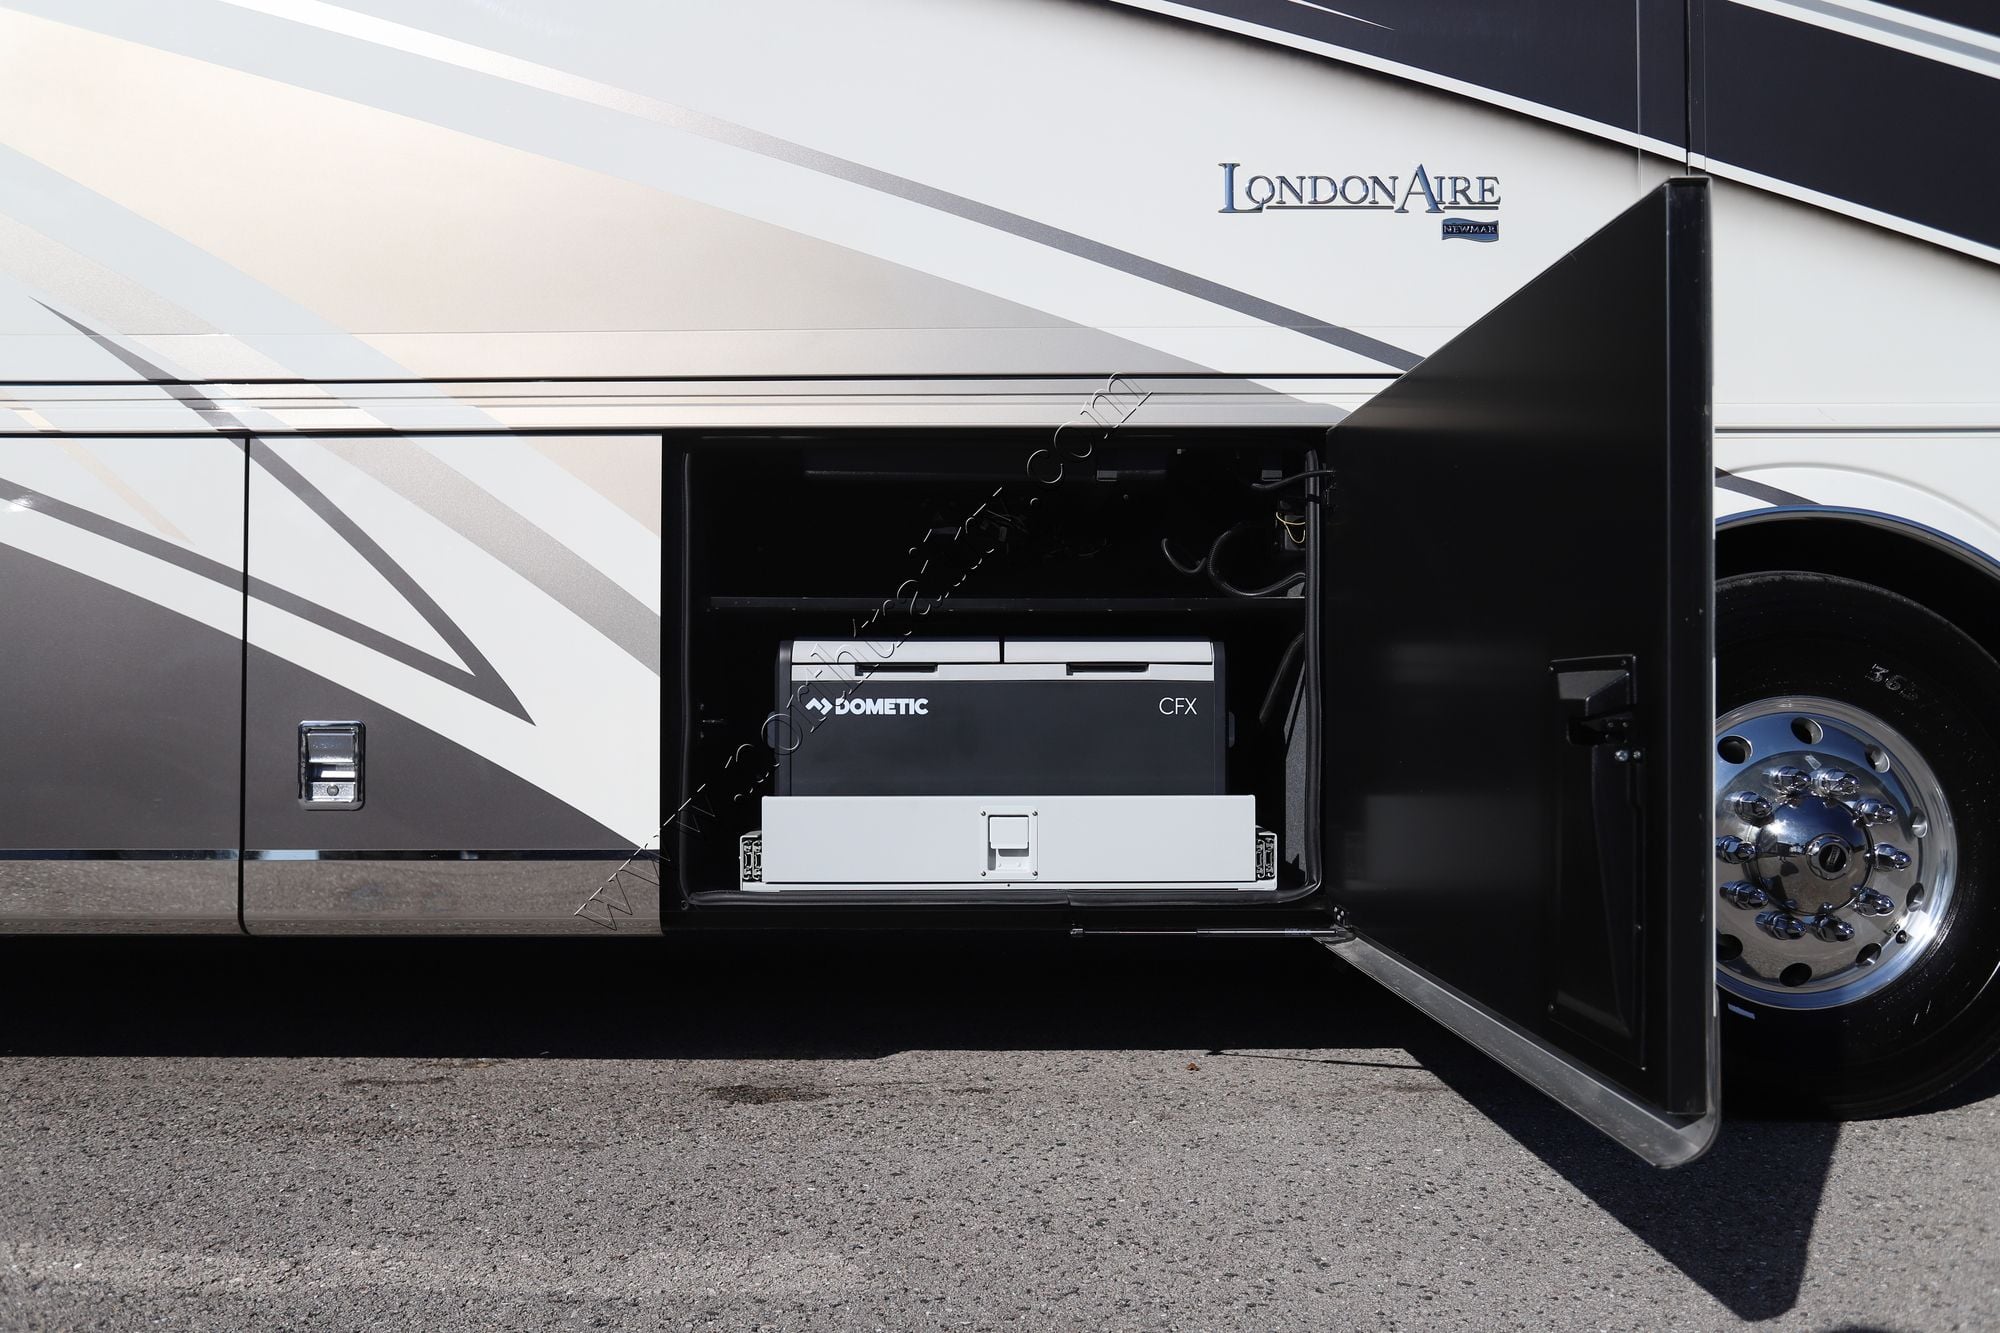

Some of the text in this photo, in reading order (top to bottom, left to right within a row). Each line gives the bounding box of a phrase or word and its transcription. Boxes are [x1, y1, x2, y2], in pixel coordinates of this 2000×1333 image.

[1443, 224, 1496, 233] NEWMAR
[835, 697, 929, 715] DOMETIC
[1159, 697, 1197, 715] CFX
